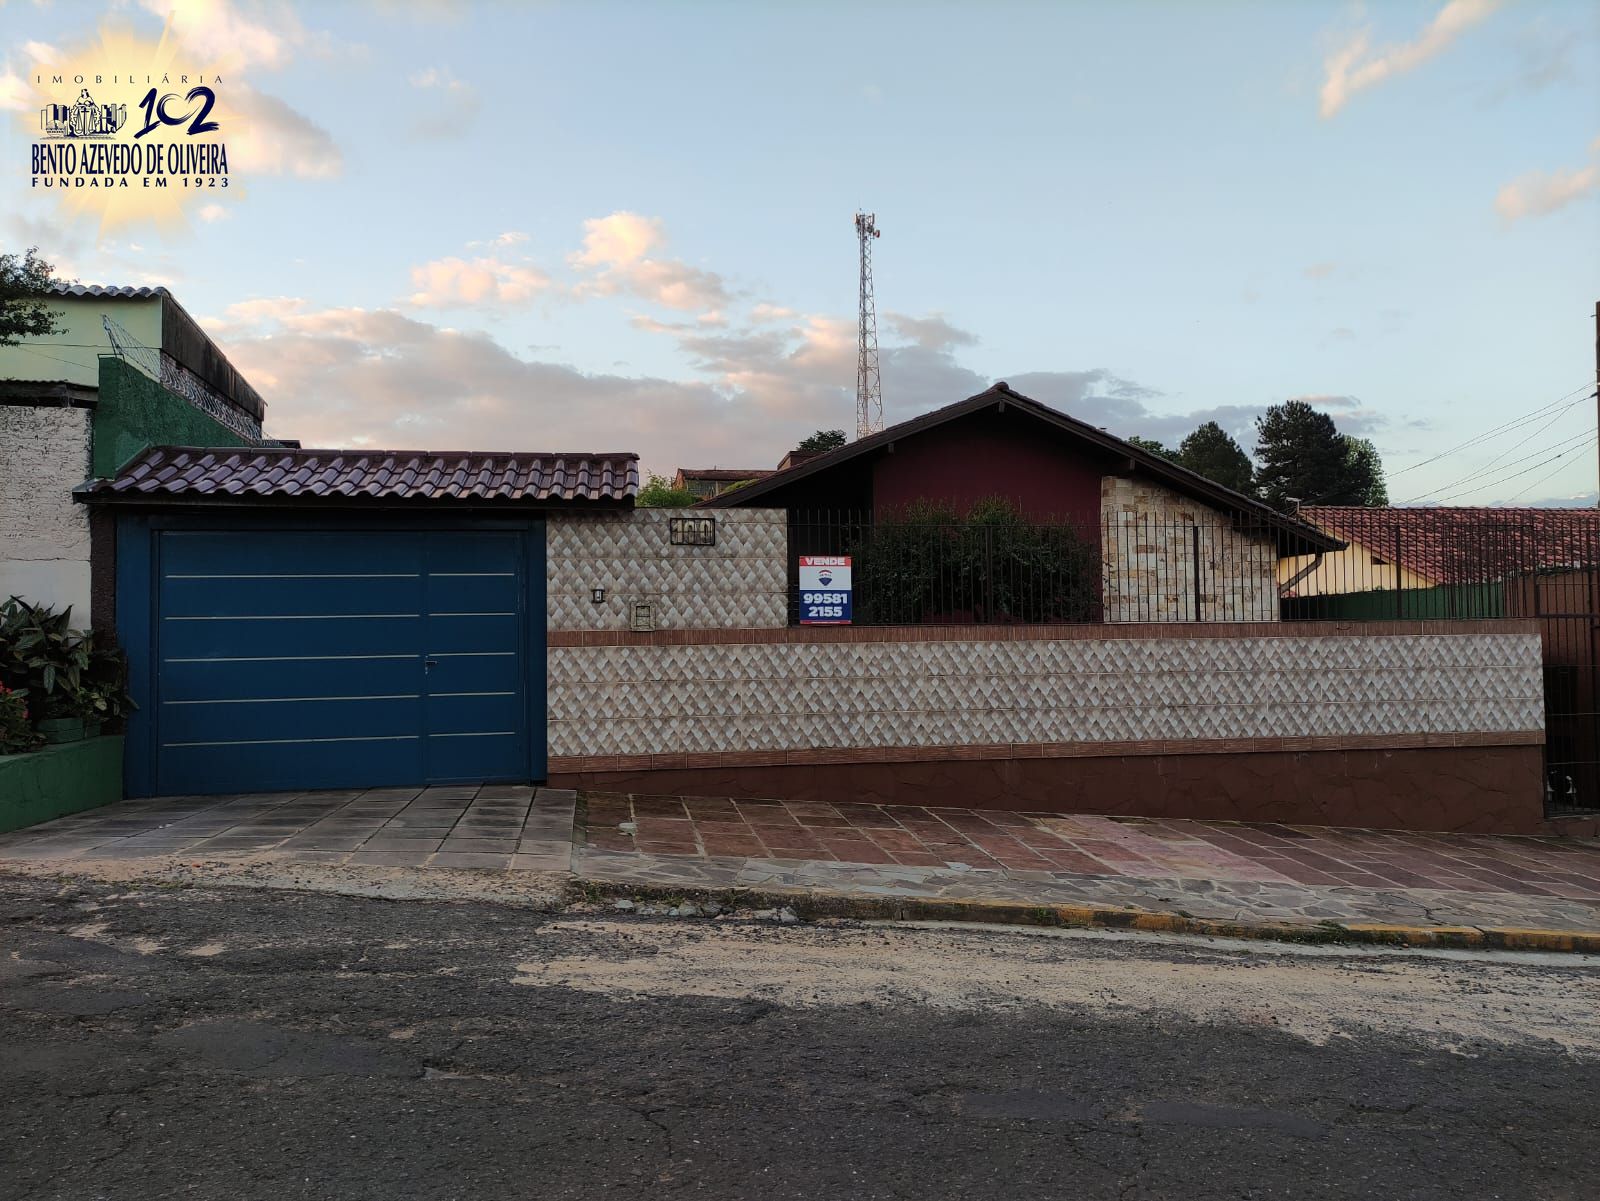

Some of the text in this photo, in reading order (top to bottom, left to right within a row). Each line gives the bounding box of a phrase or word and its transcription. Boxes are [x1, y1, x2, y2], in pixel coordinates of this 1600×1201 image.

[805, 557, 846, 566] VENDE
[803, 593, 848, 604] 99581
[808, 606, 843, 617] 2155
